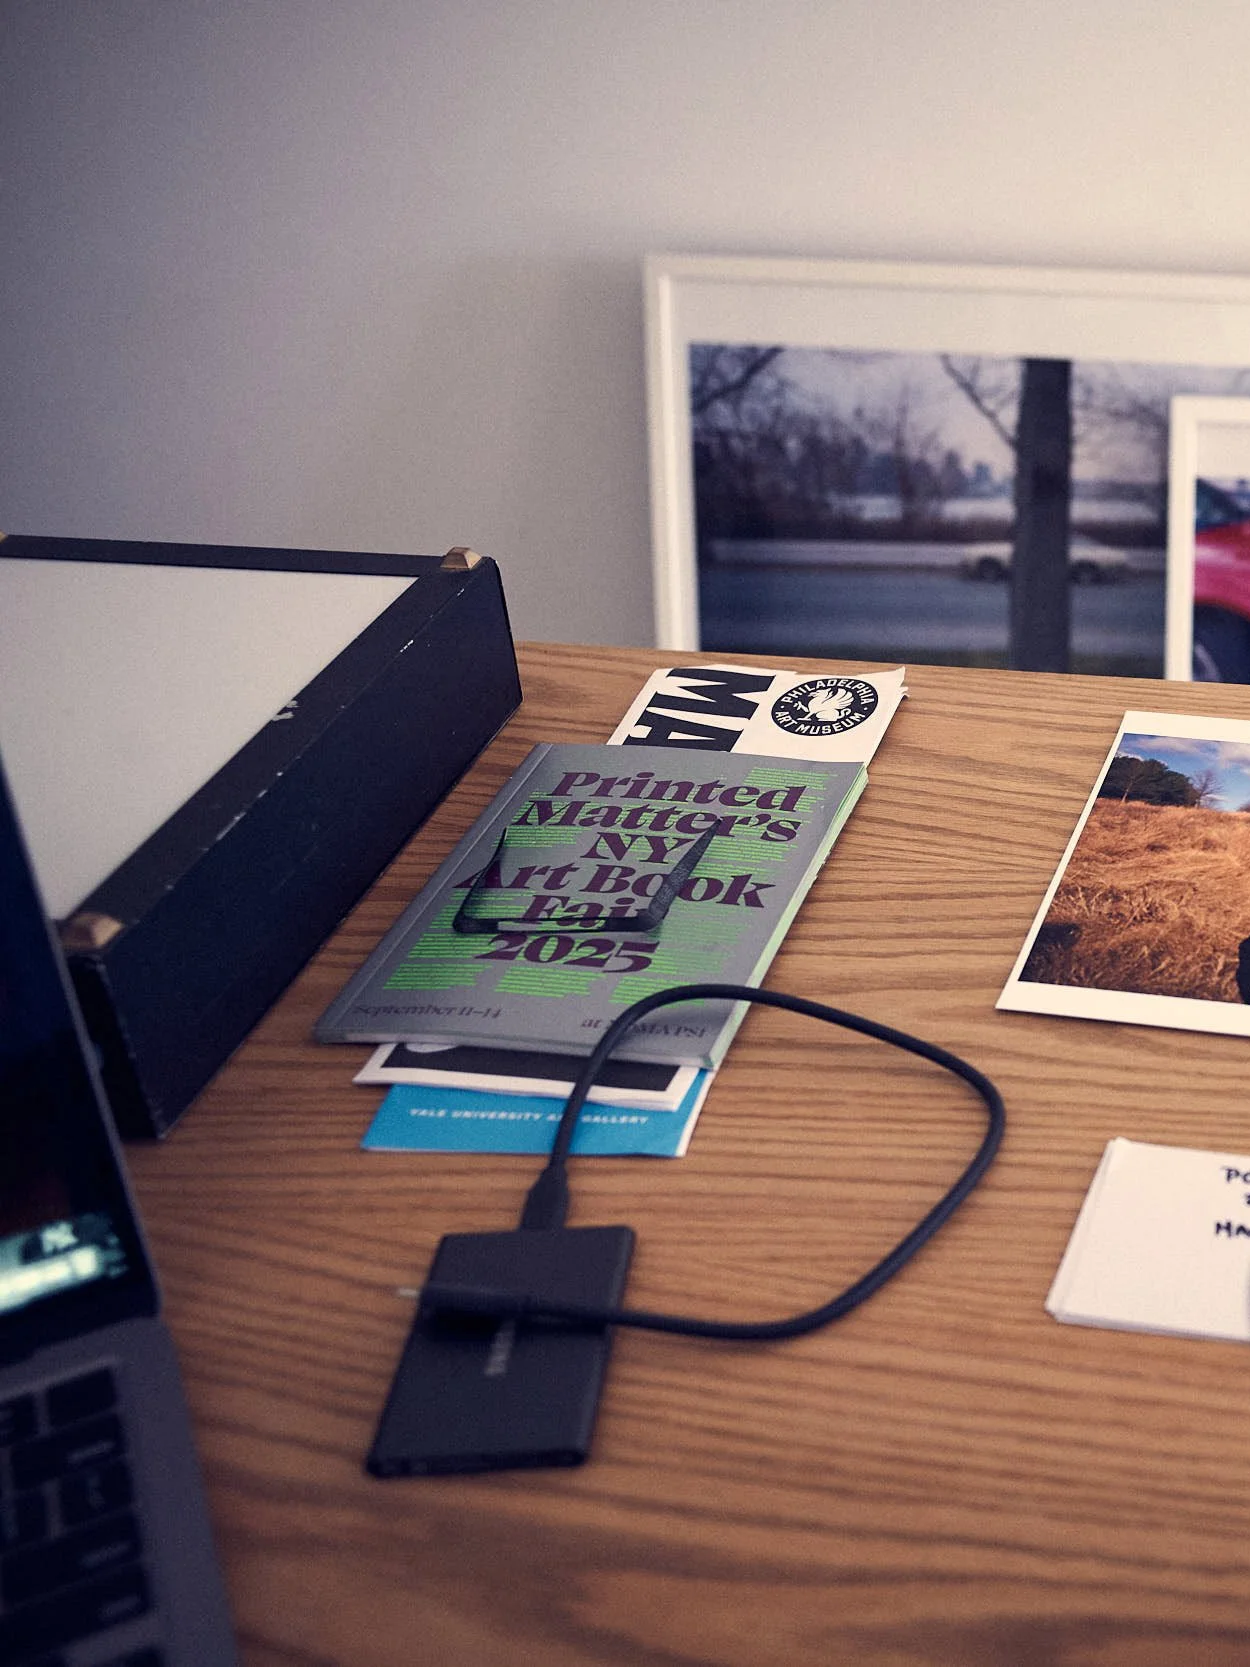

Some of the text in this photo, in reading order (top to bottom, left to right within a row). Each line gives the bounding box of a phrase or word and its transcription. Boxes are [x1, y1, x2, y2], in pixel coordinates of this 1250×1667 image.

[786, 678, 875, 705] PHILADELPHIA
[774, 710, 866, 735] ART MUSEUM
[548, 771, 806, 812] Printed
[511, 800, 801, 842] Matter's
[580, 832, 695, 864] NY
[452, 860, 580, 891] Art
[579, 864, 776, 909] Book
[474, 932, 660, 974] 2025
[410, 1108, 447, 1118] YALE
[452, 1110, 543, 1121] UNIVERSITY
